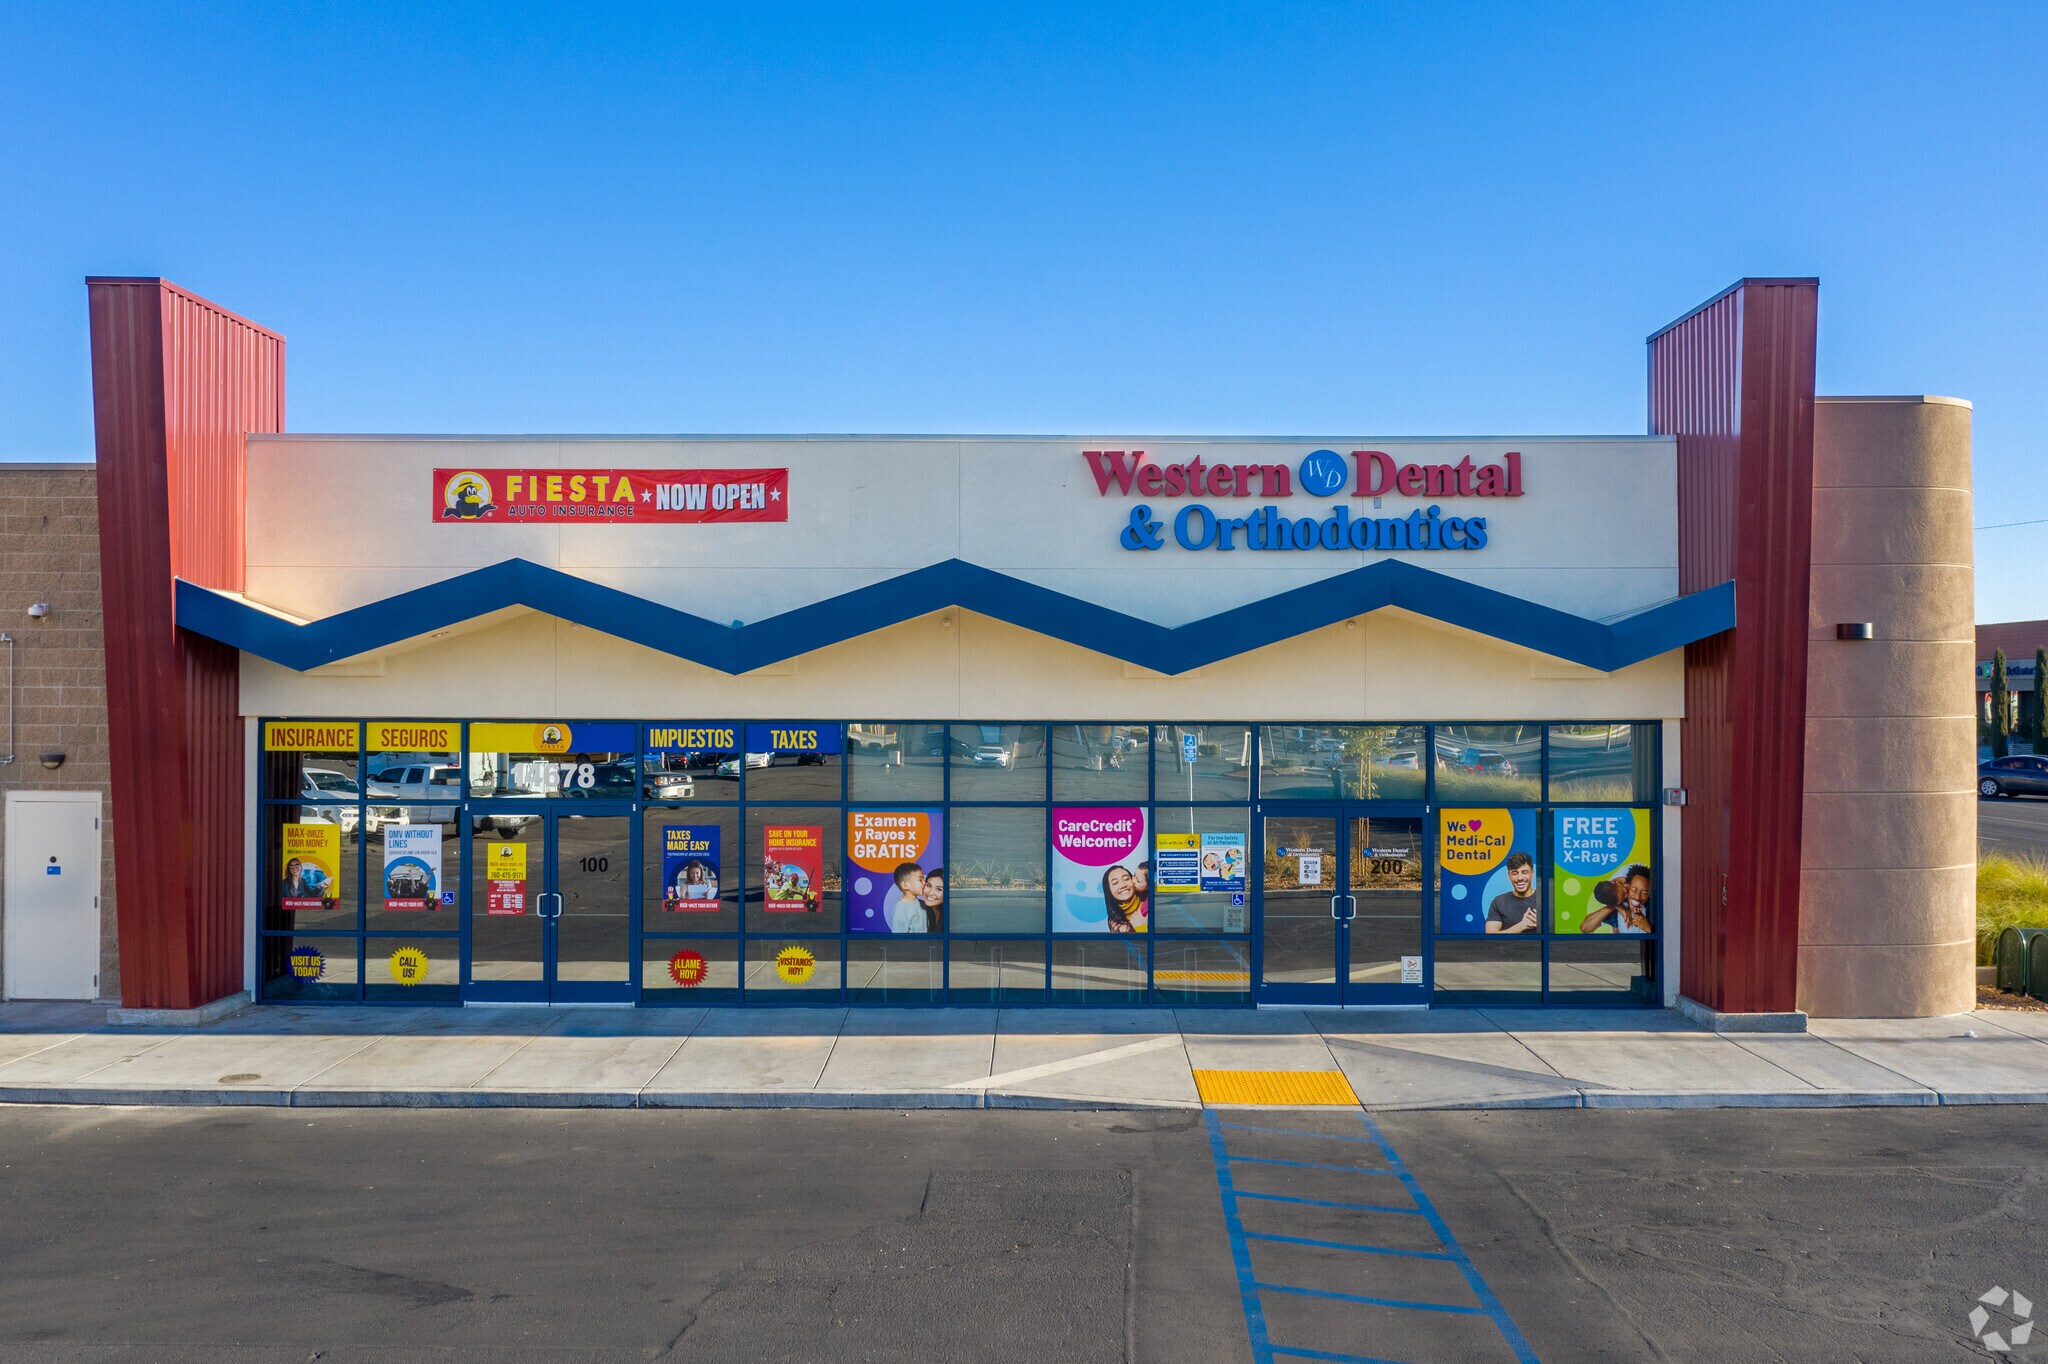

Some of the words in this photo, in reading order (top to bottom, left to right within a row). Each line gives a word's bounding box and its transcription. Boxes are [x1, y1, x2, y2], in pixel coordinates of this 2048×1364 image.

[1083, 451, 1294, 497] Western
[1351, 450, 1526, 498] Dental
[506, 475, 636, 502] FIESTA
[656, 483, 707, 511] NOW
[711, 482, 766, 510] OPEN
[508, 505, 547, 517] AUTO
[553, 505, 635, 517] INSURANCE
[1120, 504, 1165, 551] &
[1174, 504, 1488, 551] Orthodontics
[271, 728, 355, 748] INSURANCE
[381, 729, 448, 748] SEGUROS
[650, 728, 734, 749] IMPUESTOS
[771, 729, 818, 749] TAXES
[511, 763, 595, 789] 14678
[854, 813, 917, 827] Examen
[1447, 820, 1467, 832] We
[287, 827, 325, 839] MAX-IMIZE
[388, 830, 403, 839] DMV
[404, 829, 434, 839] WITHOUT
[667, 830, 691, 840] TAXES
[768, 829, 783, 838] SAVE
[784, 829, 792, 838] ON
[792, 829, 808, 838] YOUR
[854, 830, 863, 843] y
[865, 828, 905, 843] Rayos
[908, 830, 916, 840] x
[287, 839, 304, 848] YOUR
[306, 839, 329, 848] MONEY
[388, 839, 408, 849] LINES
[667, 840, 688, 851] MADE
[690, 840, 710, 851] EASY
[768, 838, 785, 847] HOME
[786, 838, 817, 847] INSURANCE
[1058, 834, 1132, 848] Welcome!
[1447, 835, 1506, 846] Medi-Cal
[1563, 837, 1603, 849] Exam
[1607, 836, 1618, 849] &
[1447, 849, 1491, 860] Dental
[1563, 850, 1618, 866] X-Rays
[579, 857, 609, 872] 100
[1371, 859, 1402, 875] 200
[290, 955, 309, 967] VISIT
[311, 955, 321, 967] US
[399, 956, 418, 968] CALL
[293, 966, 321, 977] TODAY!
[402, 968, 415, 979] US!
[679, 969, 697, 980] HOY!
[788, 966, 804, 976] HOY!
